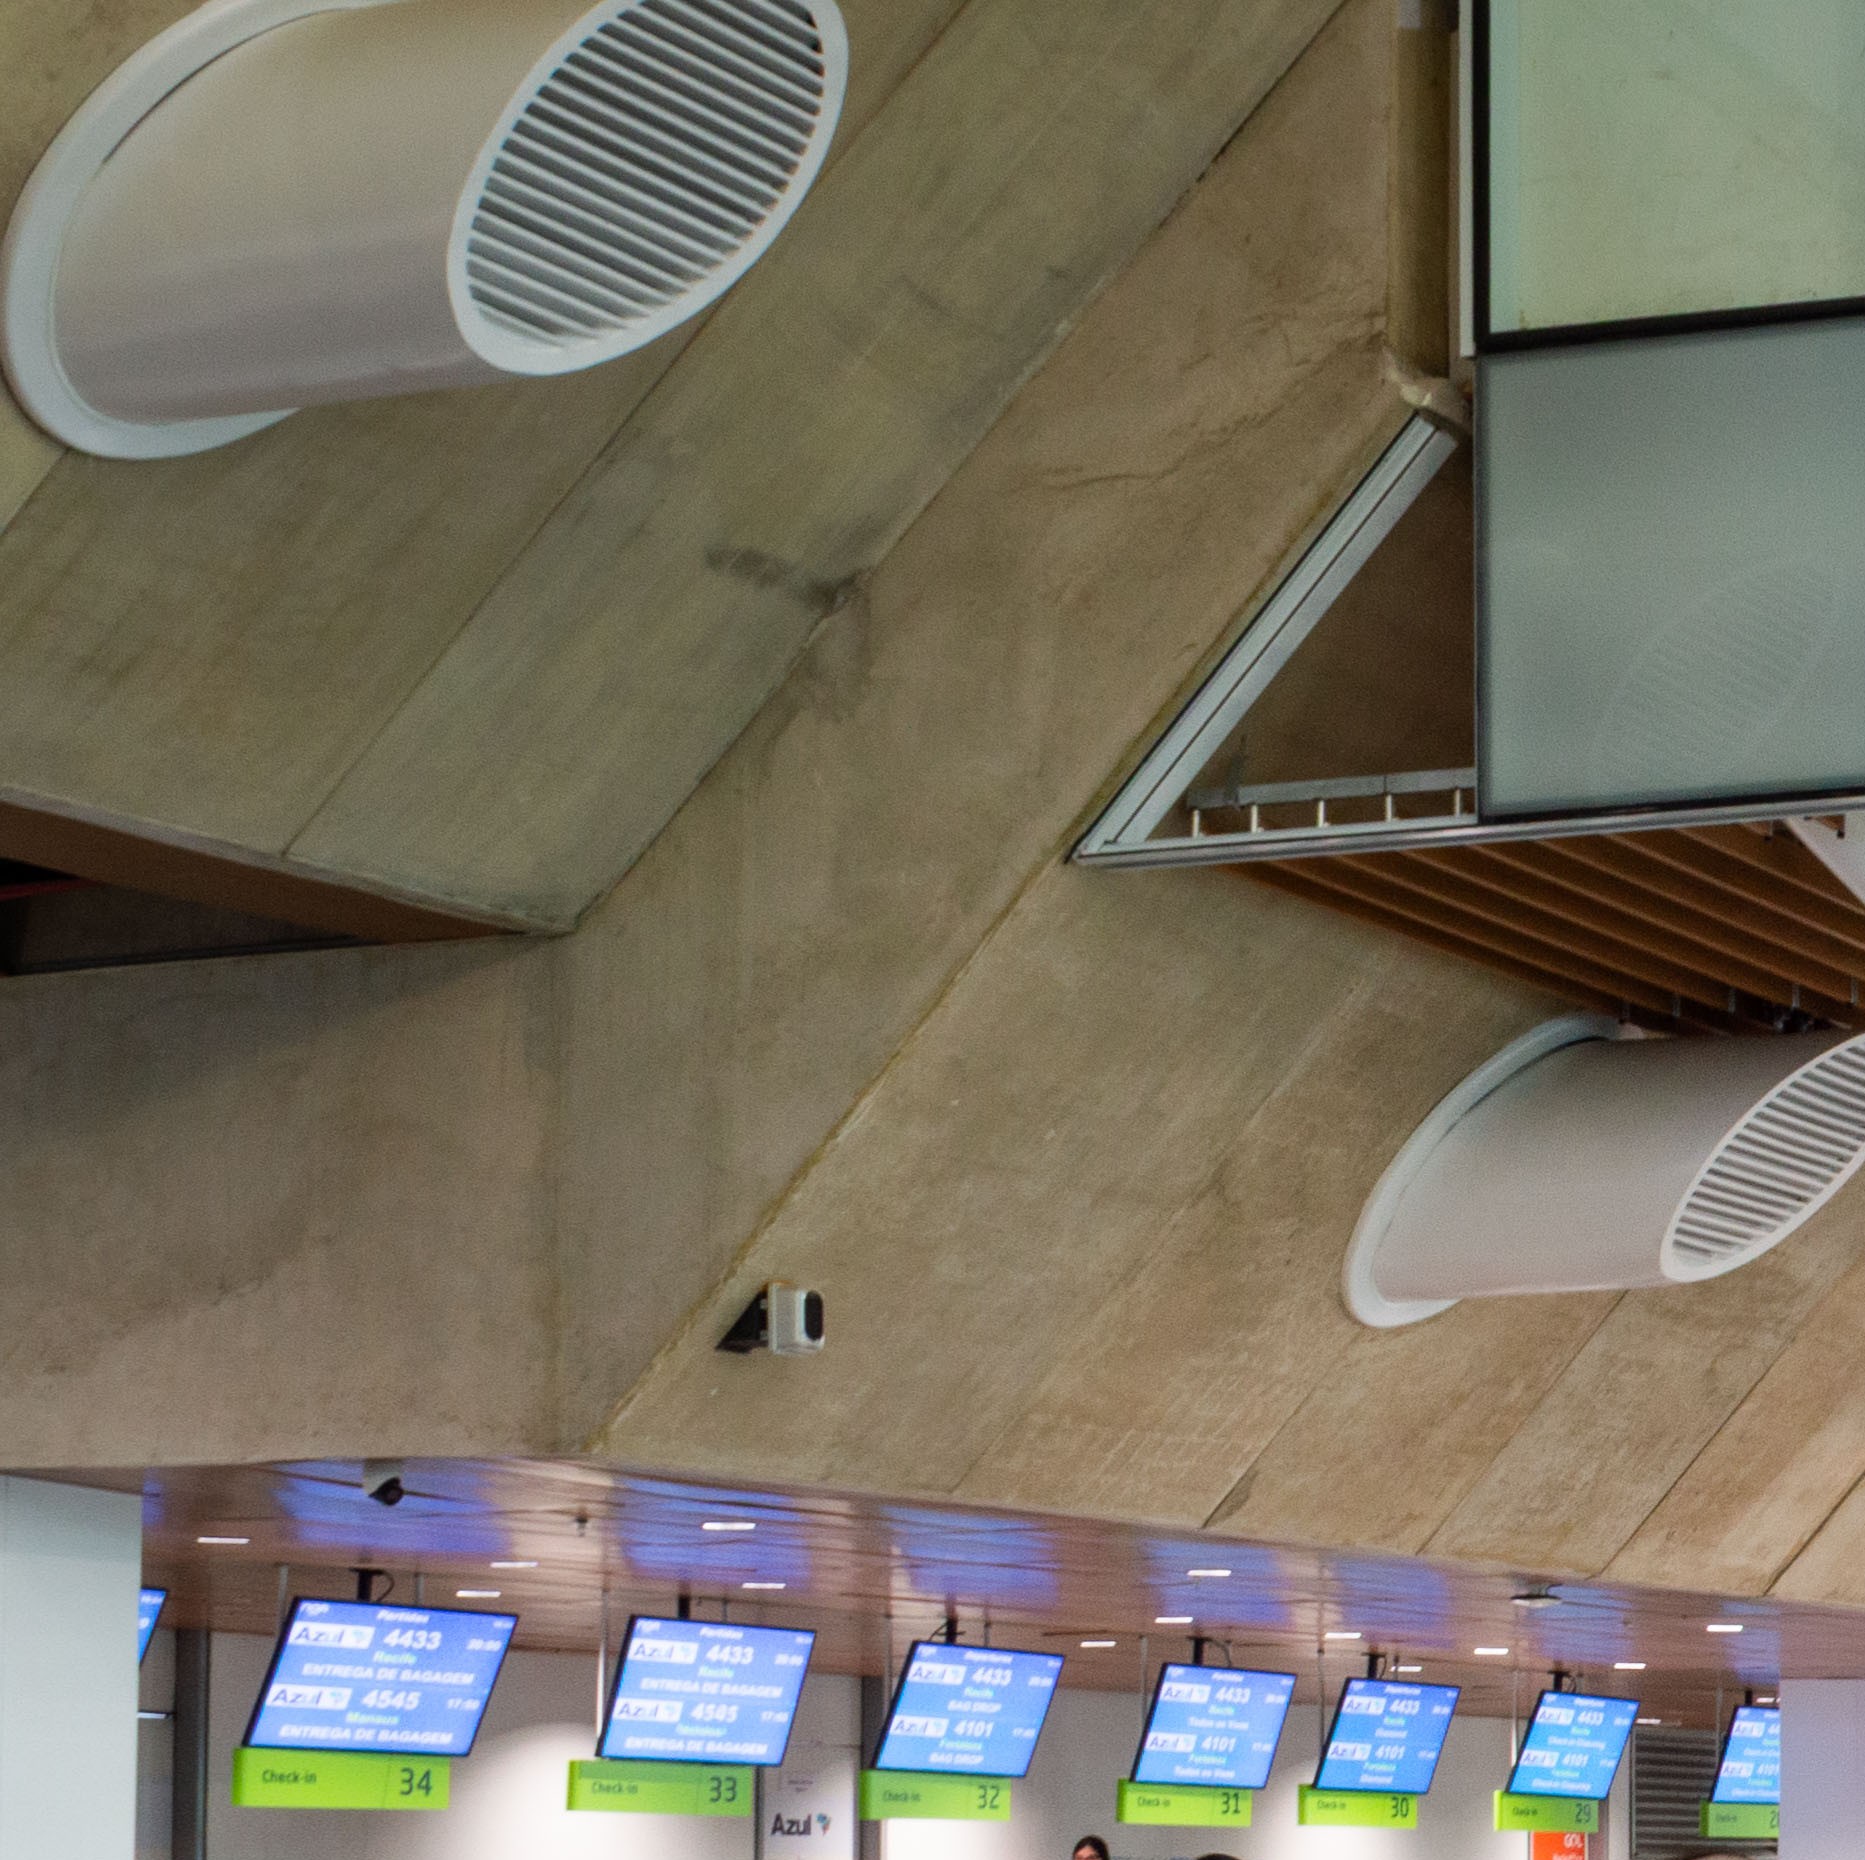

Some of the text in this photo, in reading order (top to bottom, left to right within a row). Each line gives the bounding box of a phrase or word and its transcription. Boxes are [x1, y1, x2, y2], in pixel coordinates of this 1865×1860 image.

[383, 1629, 443, 1651] 4433
[633, 1643, 675, 1659] Azl
[705, 1644, 755, 1666] 4433
[301, 1663, 475, 1685] ENTREGA DE BAGAGEM
[912, 1665, 945, 1680] Azl
[639, 1677, 785, 1699] ENTREGA DE BAGAGEM
[1163, 1686, 1193, 1699] Azl
[361, 1689, 422, 1711] 4545
[1345, 1697, 1372, 1710] Azl
[618, 1702, 659, 1717] Azl
[1538, 1708, 1562, 1721] Azl
[279, 1724, 455, 1745] ENTREGA DE BAGAGEM
[894, 1719, 928, 1733] Azl
[954, 1720, 995, 1738] 4101
[623, 1736, 769, 1756] ENTREGA DE BAGAGEM
[1150, 1736, 1179, 1749] Azl
[1202, 1735, 1237, 1753] 4101
[1331, 1745, 1357, 1757] Azl
[1524, 1752, 1549, 1764] Azl
[262, 1769, 317, 1784] Check-in
[400, 1767, 433, 1797] 34
[592, 1781, 638, 1795] Check-in
[709, 1776, 737, 1803] 33
[883, 1790, 920, 1803] Check-in
[977, 1785, 1000, 1810] 32
[1222, 1792, 1241, 1815] 31
[1391, 1796, 1410, 1818] 30
[1575, 1803, 1591, 1824] 29
[771, 1812, 812, 1836] Azul
[1770, 1810, 1780, 1829] 2
[1563, 1833, 1584, 1850] GOL
